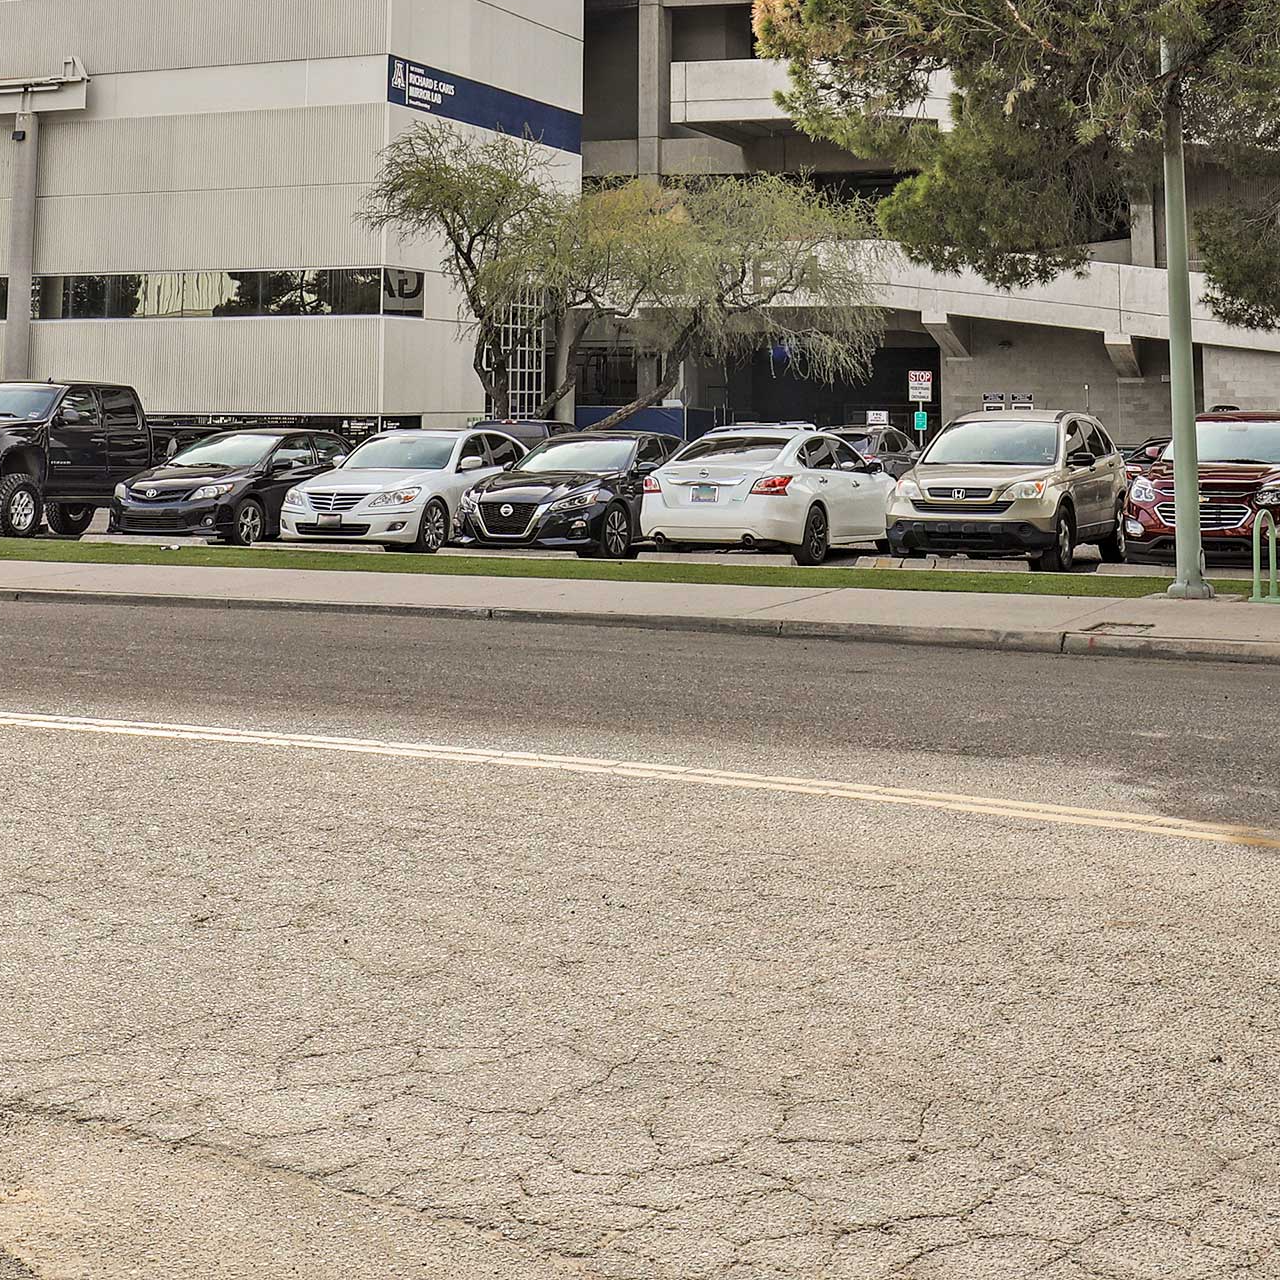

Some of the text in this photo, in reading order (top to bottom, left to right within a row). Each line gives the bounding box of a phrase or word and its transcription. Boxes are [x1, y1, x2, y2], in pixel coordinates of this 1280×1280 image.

[409, 73, 434, 90] RICHARD
[432, 92, 442, 104] LAB
[910, 371, 931, 382] STOP
